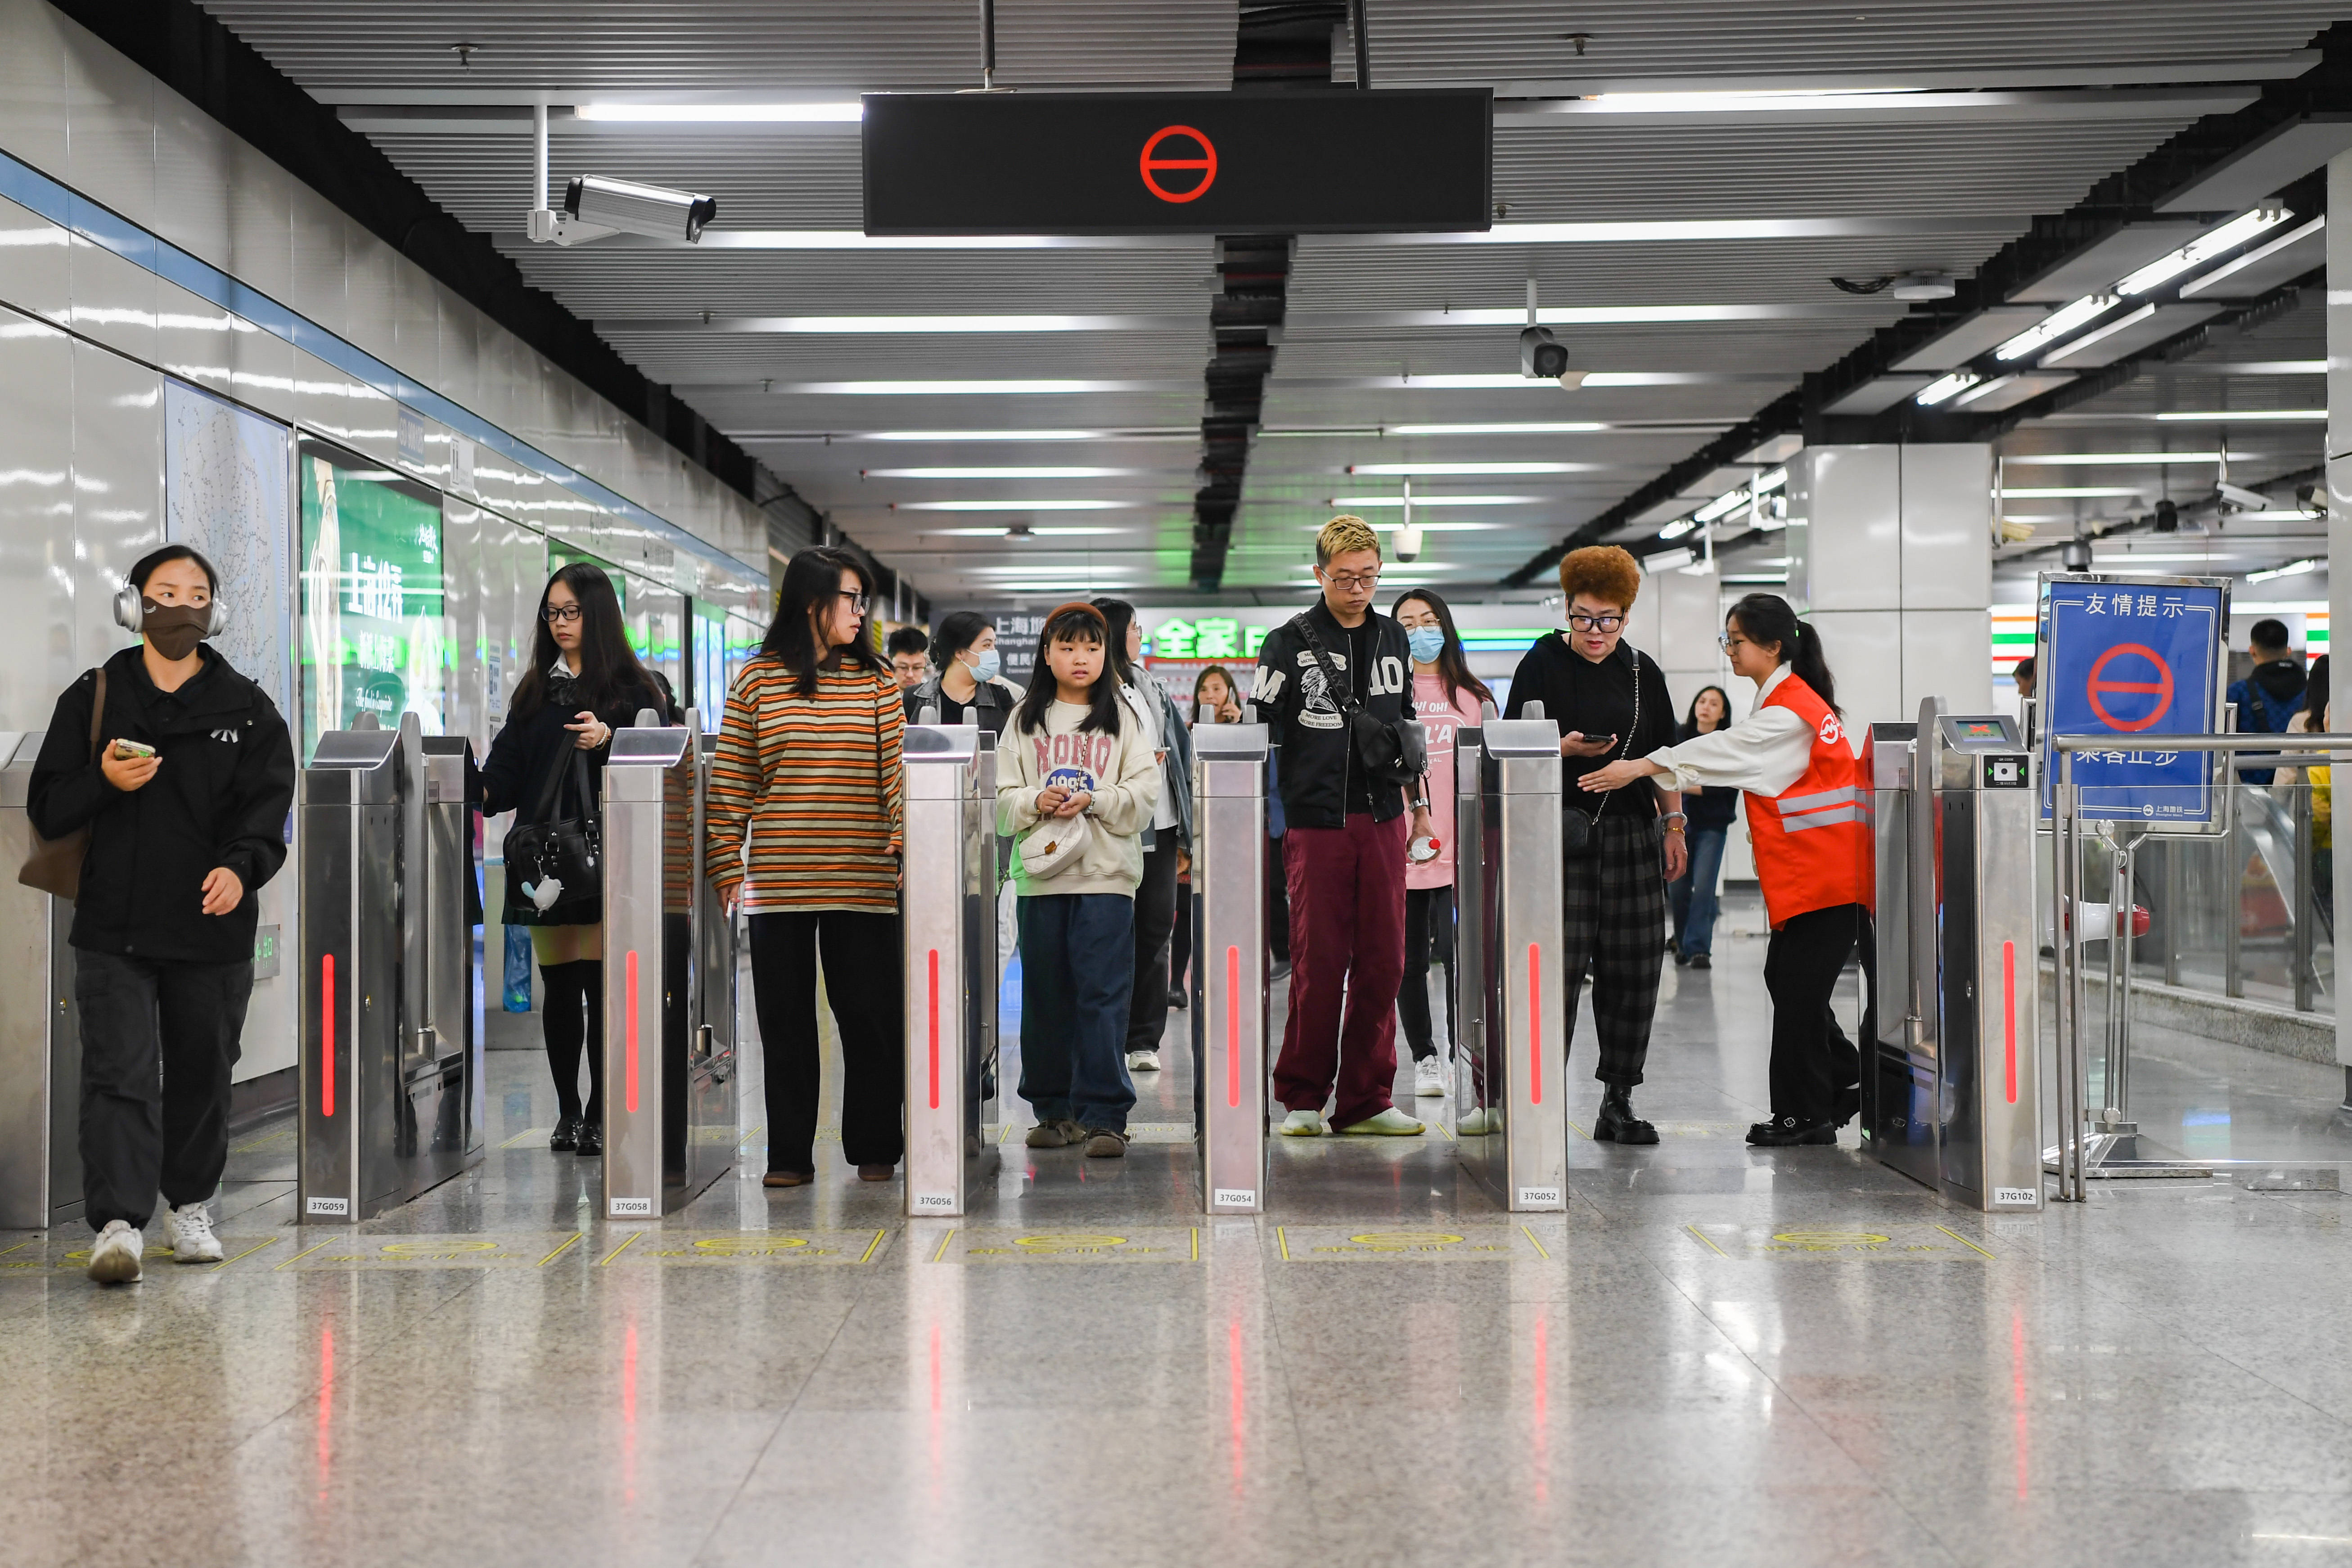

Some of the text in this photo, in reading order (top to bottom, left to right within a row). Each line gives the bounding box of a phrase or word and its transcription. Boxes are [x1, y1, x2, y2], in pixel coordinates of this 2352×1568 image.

[2085, 592, 2184, 618] 友情提示
[1154, 617, 1238, 658] 全家
[1318, 651, 1344, 687] BALLY
[1250, 665, 1286, 704] M
[1429, 702, 1448, 712] OH!
[1300, 717, 1315, 726] MORE
[2156, 805, 2183, 813] 上海地铁
[263, 934, 272, 958] 出口
[920, 1197, 951, 1205] 37G056
[1220, 1194, 1252, 1202] 37G054
[312, 1202, 344, 1211] 37G059
